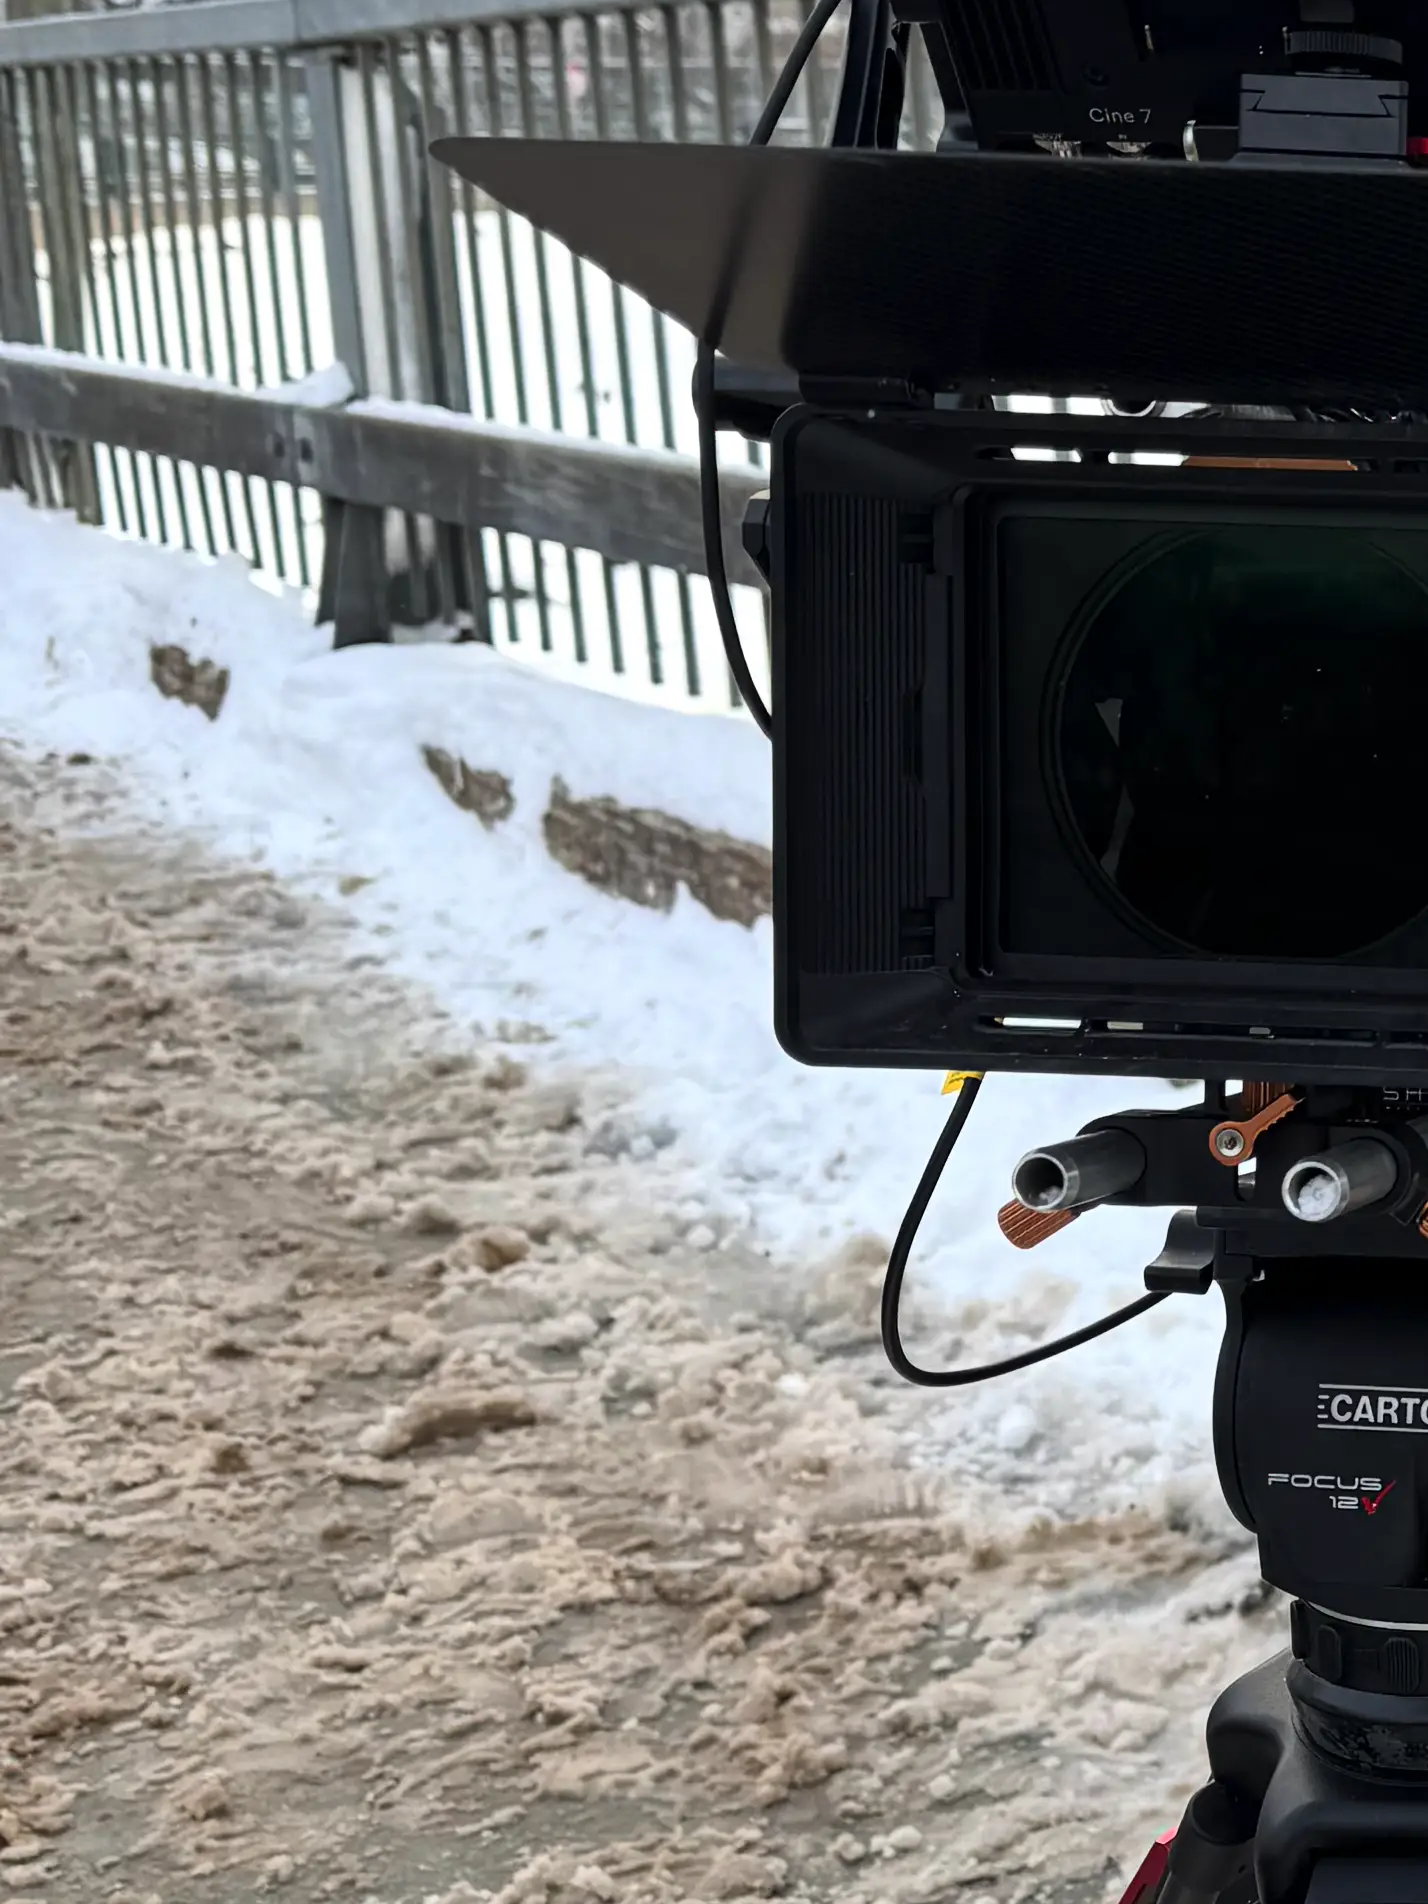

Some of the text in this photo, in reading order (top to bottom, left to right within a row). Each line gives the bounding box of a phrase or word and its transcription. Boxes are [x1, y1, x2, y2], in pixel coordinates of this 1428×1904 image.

[1089, 107, 1152, 124] Cine 7
[1268, 1472, 1382, 1491] FOCUS
